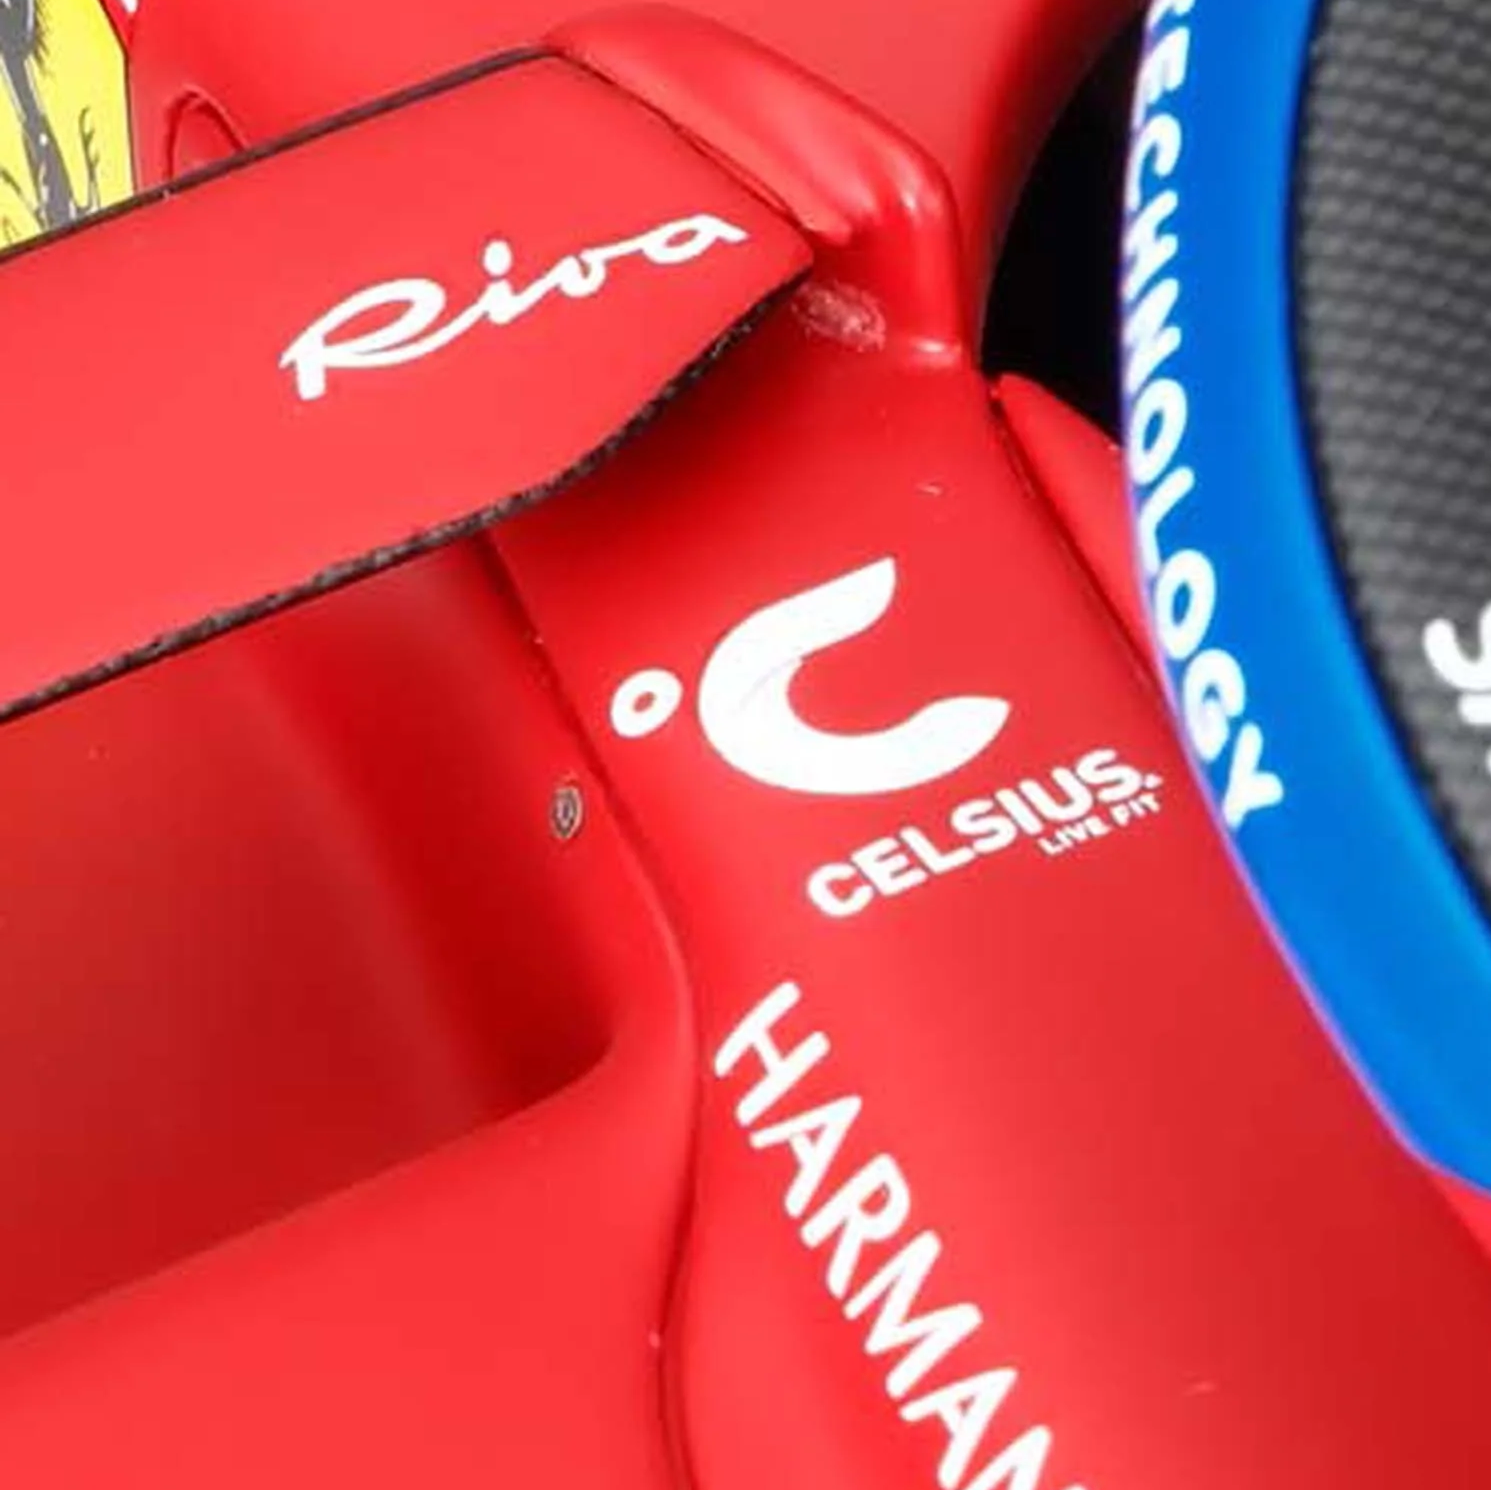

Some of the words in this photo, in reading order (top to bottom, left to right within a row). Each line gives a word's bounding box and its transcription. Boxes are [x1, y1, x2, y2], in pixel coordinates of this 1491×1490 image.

[280, 214, 747, 400] Riva
[1037, 815, 1112, 855] LIVE
[1109, 793, 1160, 827] FIT
